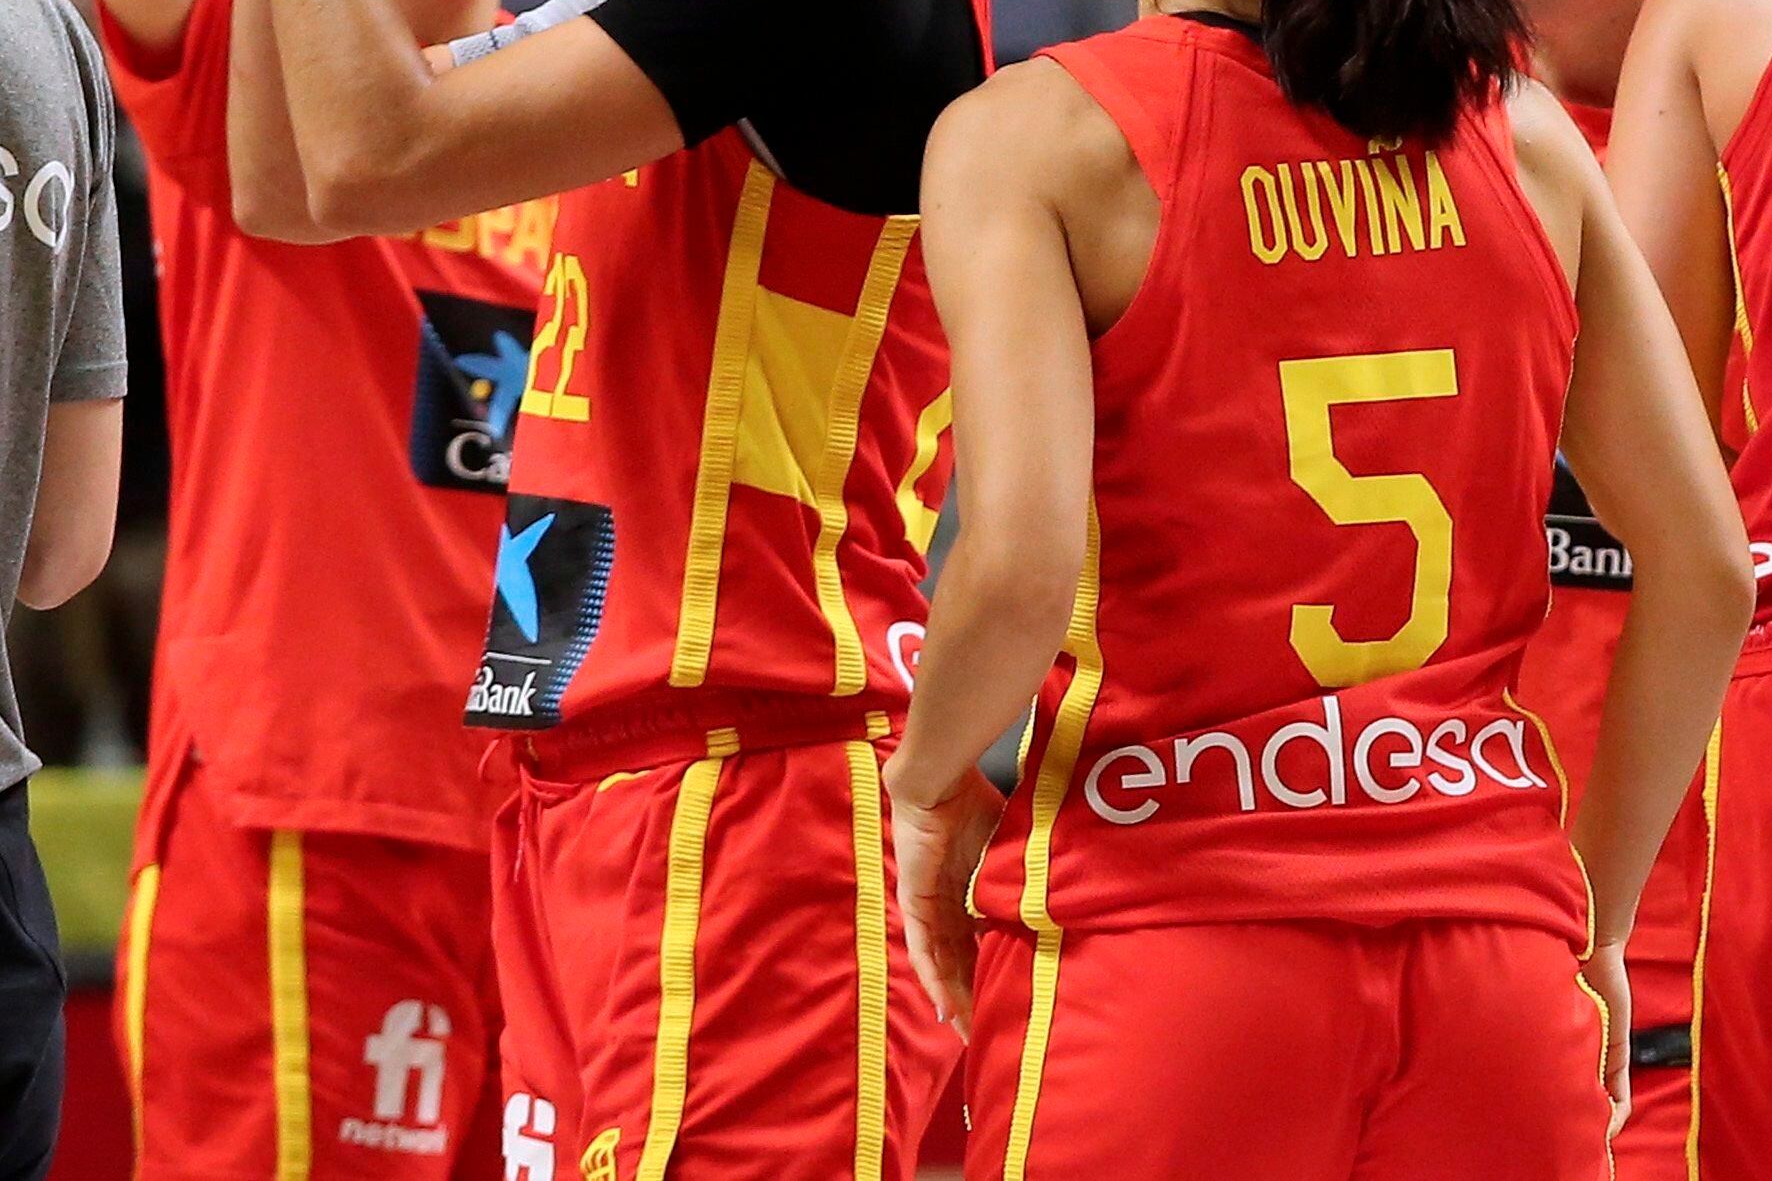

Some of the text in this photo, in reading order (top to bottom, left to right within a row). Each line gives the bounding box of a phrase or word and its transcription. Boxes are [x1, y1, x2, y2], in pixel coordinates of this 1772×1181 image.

[1240, 135, 1467, 264] OUVIÑA
[519, 252, 591, 422] 22
[1279, 348, 1458, 687] 5
[1083, 695, 1547, 825] endesa
